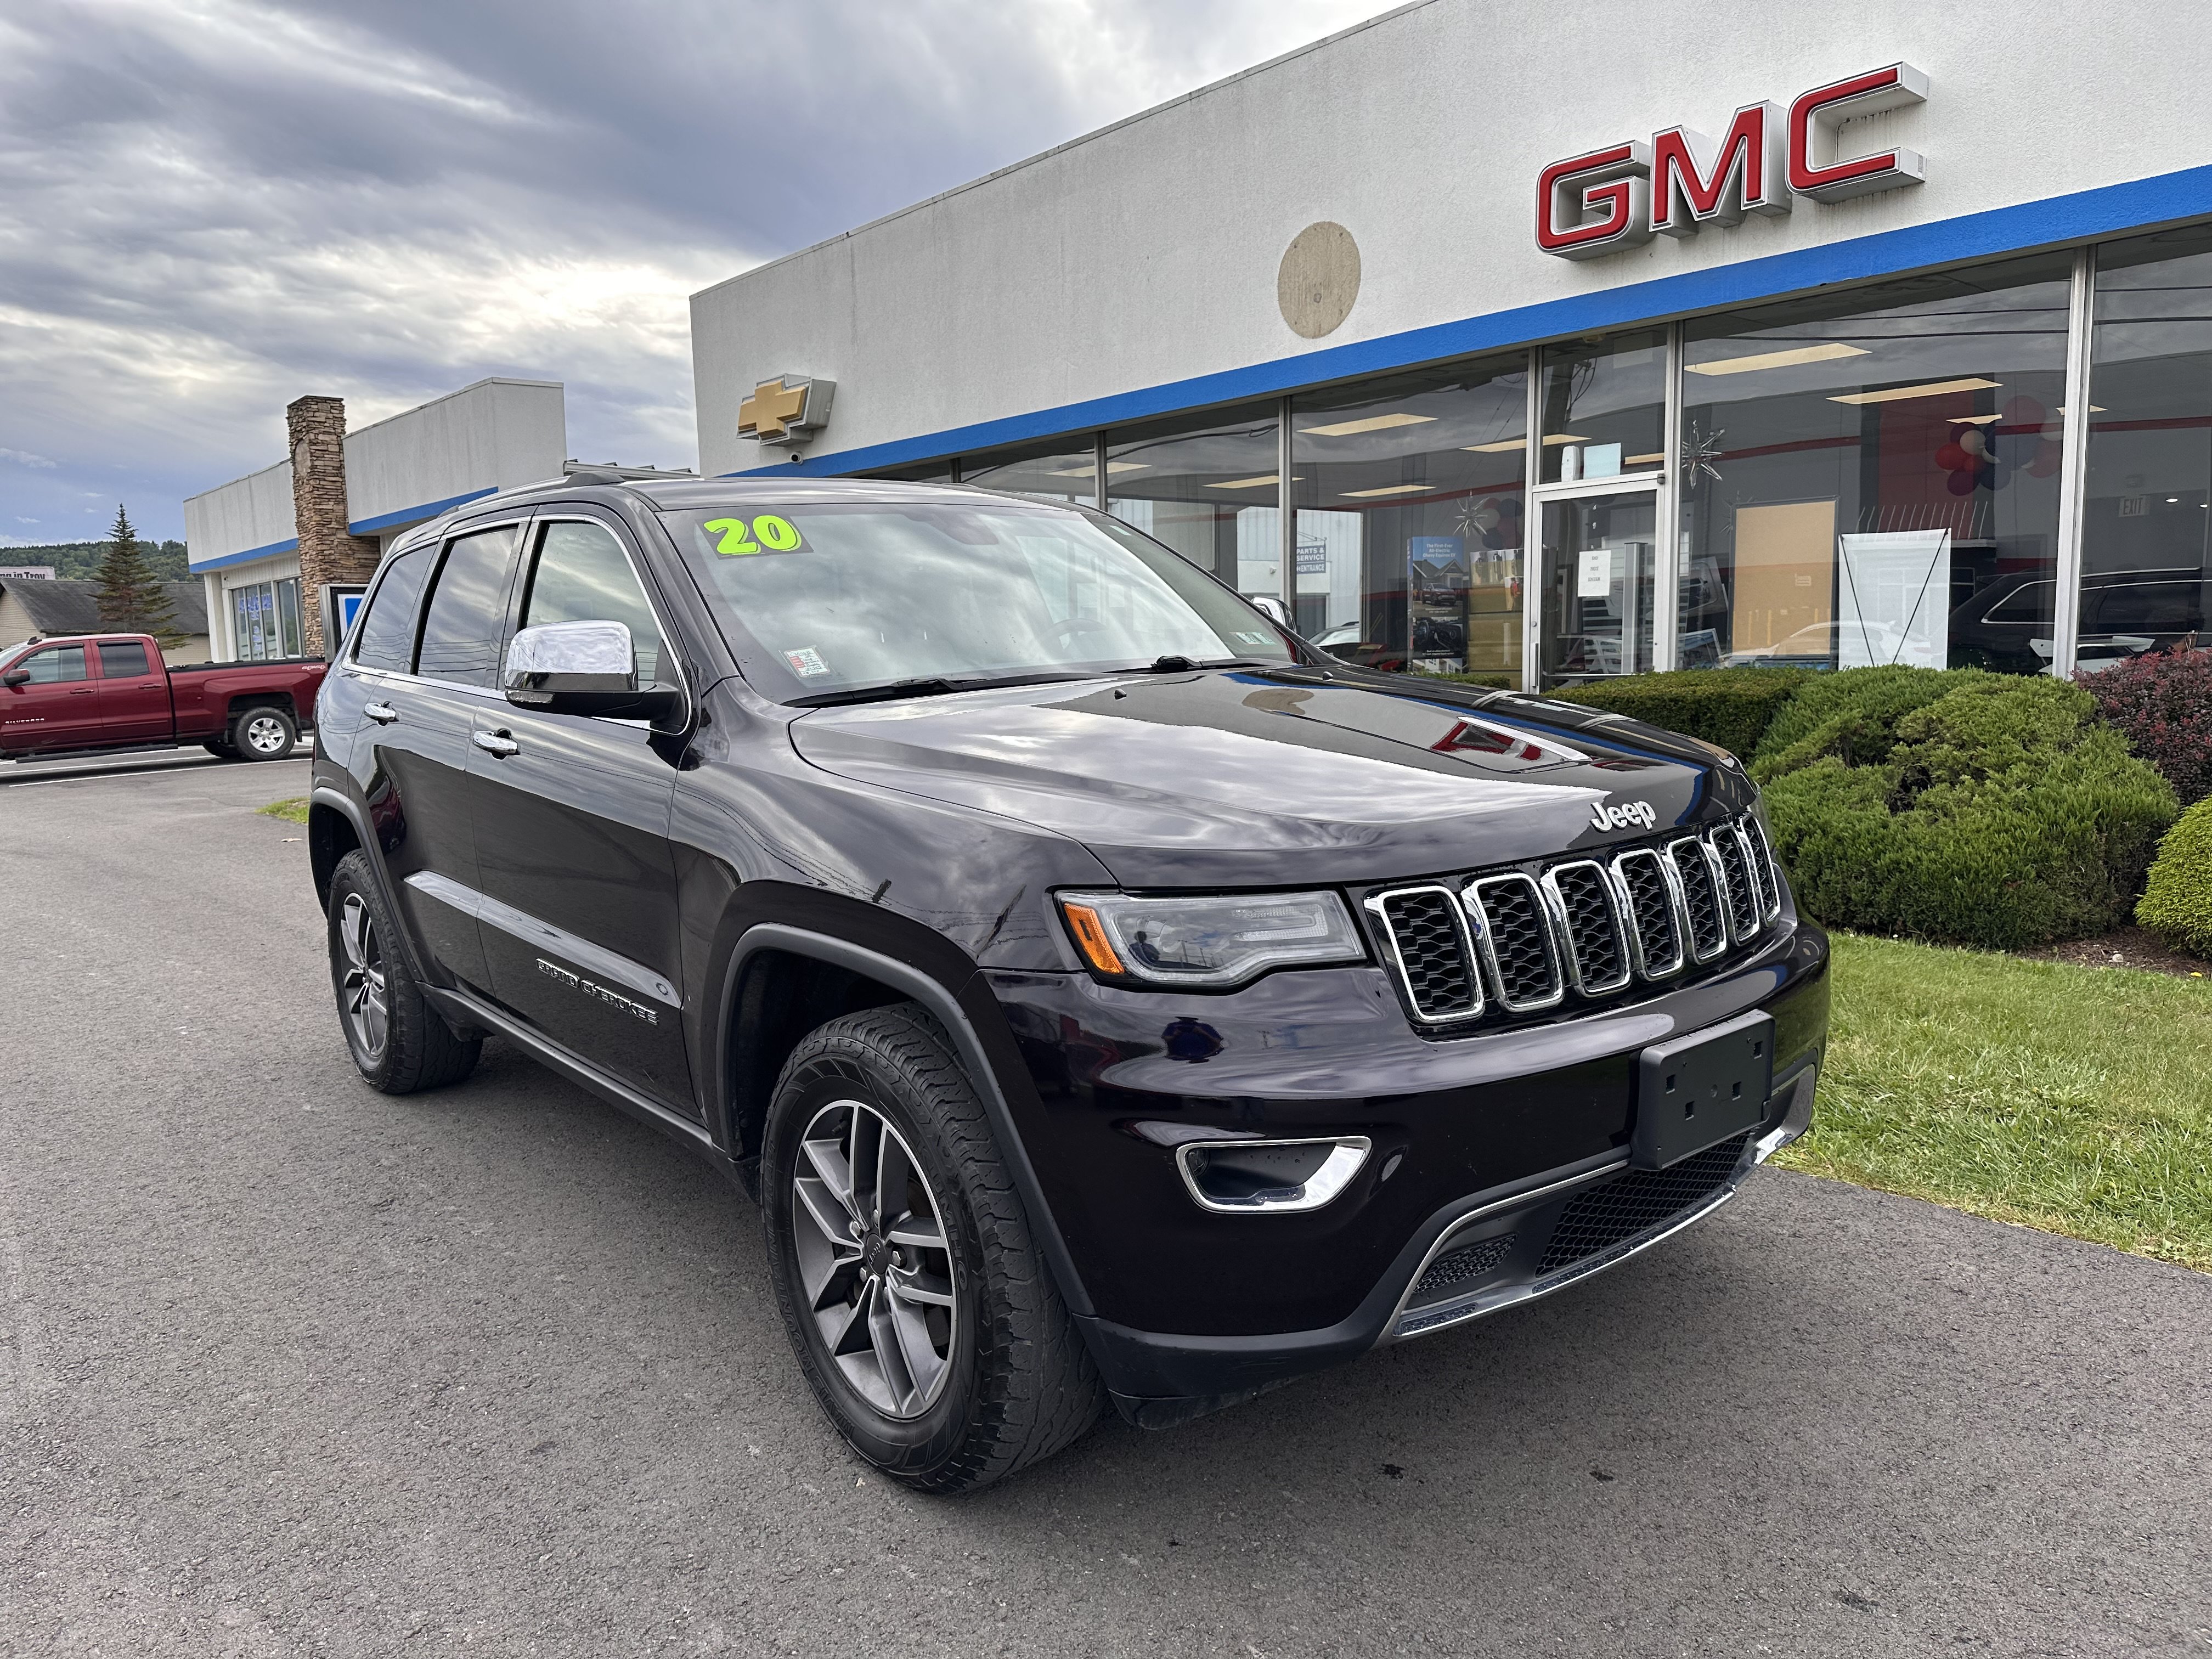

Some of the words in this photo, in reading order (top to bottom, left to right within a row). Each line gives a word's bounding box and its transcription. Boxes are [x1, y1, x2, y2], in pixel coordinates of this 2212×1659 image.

[1537, 61, 1909, 254] GMC
[2123, 498, 2143, 515] EXIT
[703, 515, 802, 555] 20
[1301, 564, 1325, 572] ENTRANCE
[1590, 800, 1657, 833] Jeep
[536, 957, 580, 989] GRAND
[580, 979, 658, 1026] CHEROKEE
